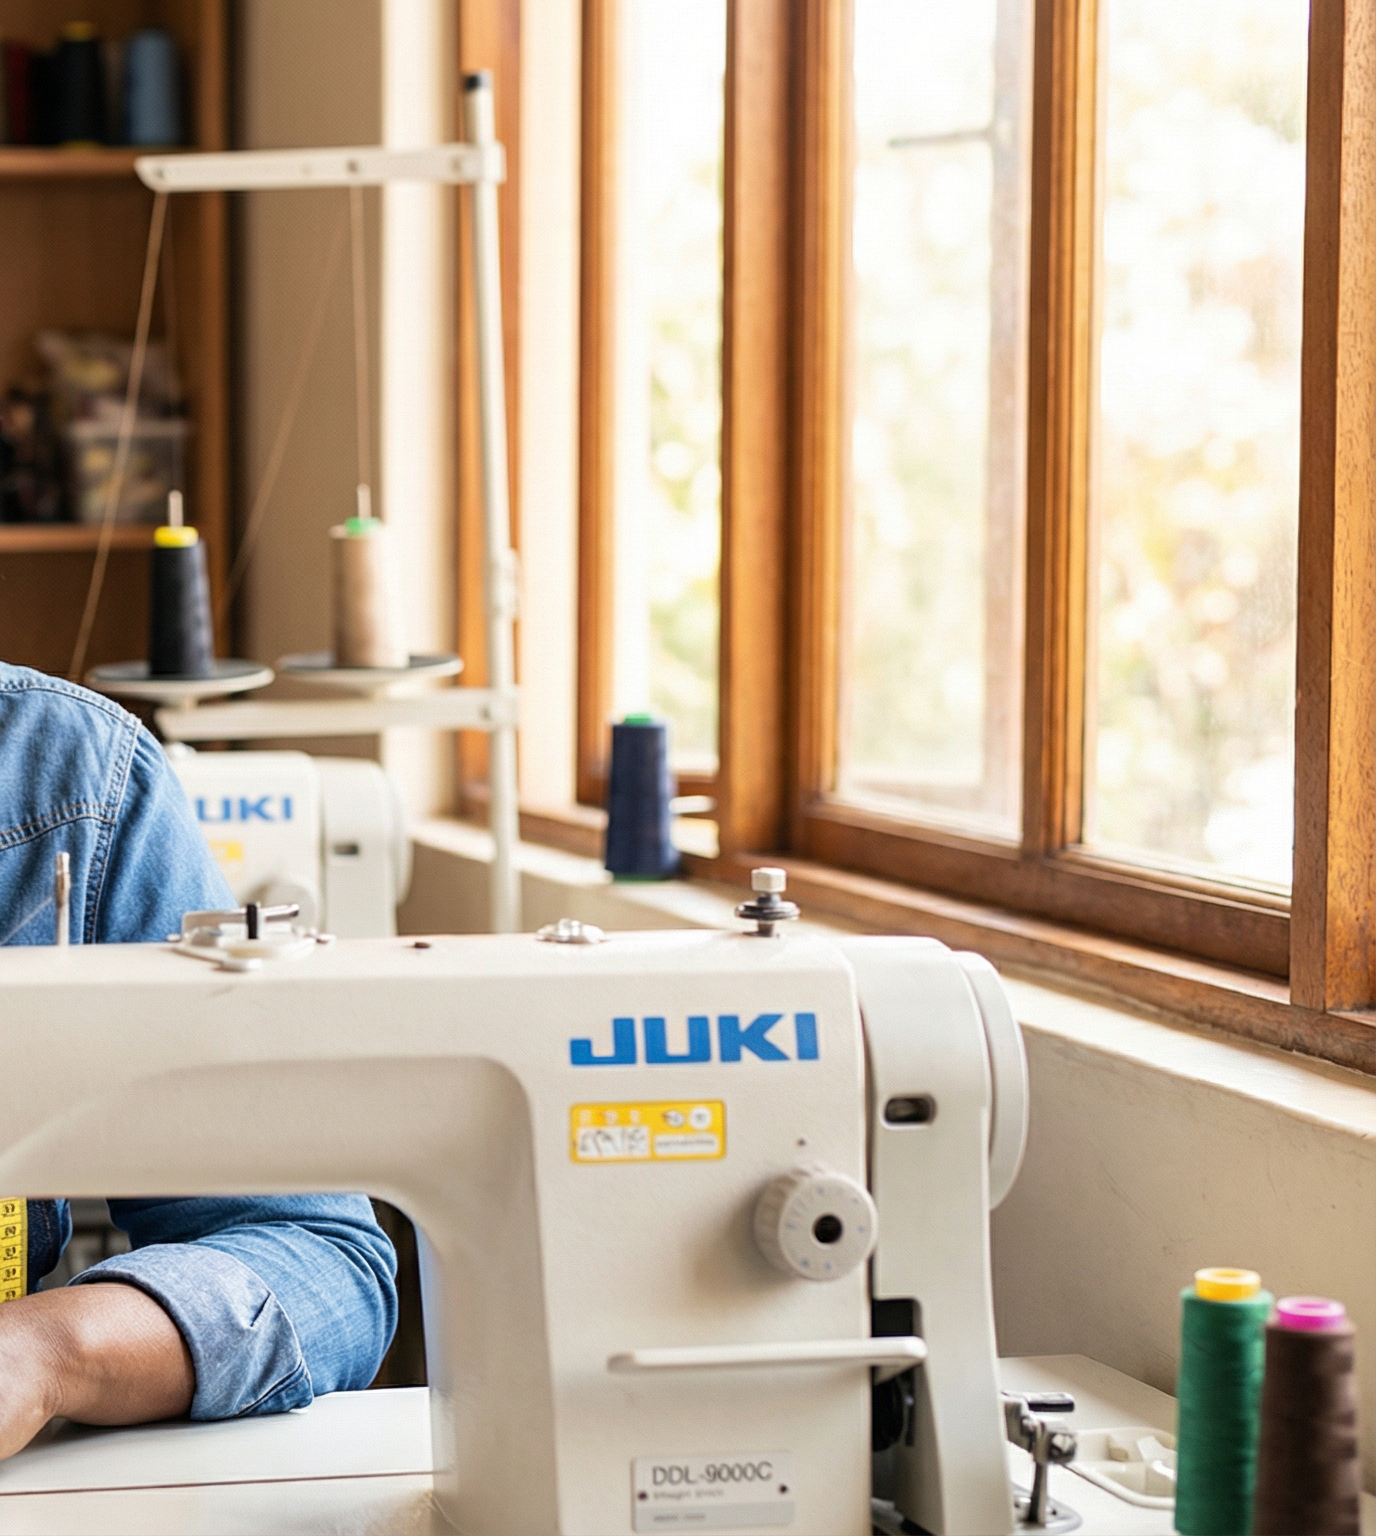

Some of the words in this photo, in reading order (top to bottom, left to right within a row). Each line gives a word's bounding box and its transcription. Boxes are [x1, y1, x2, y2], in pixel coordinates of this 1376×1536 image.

[196, 796, 293, 822] UKI
[569, 1013, 819, 1065] JUKI
[652, 1461, 773, 1486] DDL-9000C
